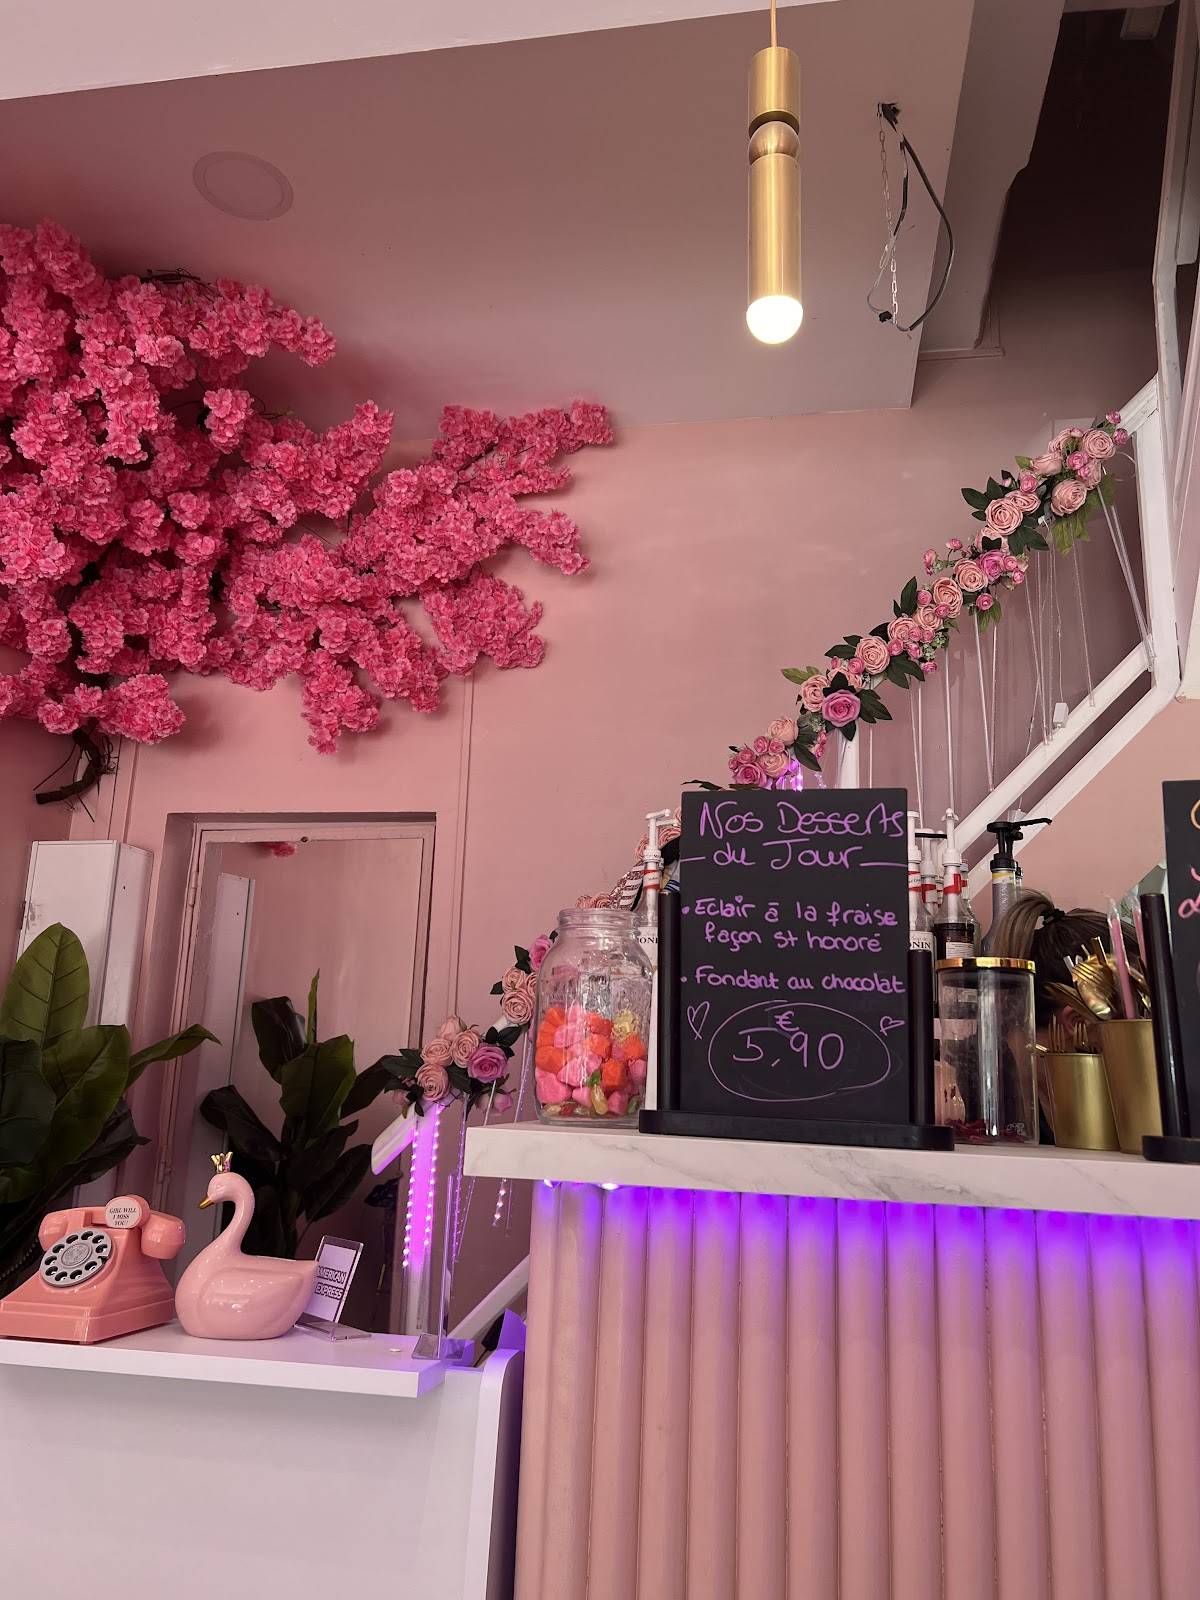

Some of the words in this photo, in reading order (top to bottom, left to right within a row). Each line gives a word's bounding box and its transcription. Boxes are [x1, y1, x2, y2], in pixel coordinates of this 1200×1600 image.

[700, 801, 763, 839] Nos
[776, 801, 905, 838] Desserts
[713, 842, 756, 866] du
[762, 838, 864, 870] Jour
[695, 895, 756, 918] Eclair
[796, 902, 817, 922] la
[826, 901, 898, 927] fraise
[705, 921, 762, 952] façon
[695, 965, 779, 990] Fondant
[787, 976, 814, 990] au
[821, 973, 905, 994] chocolat
[733, 1027, 845, 1070] 5,90
[314, 1282, 345, 1300] EXPRESS
